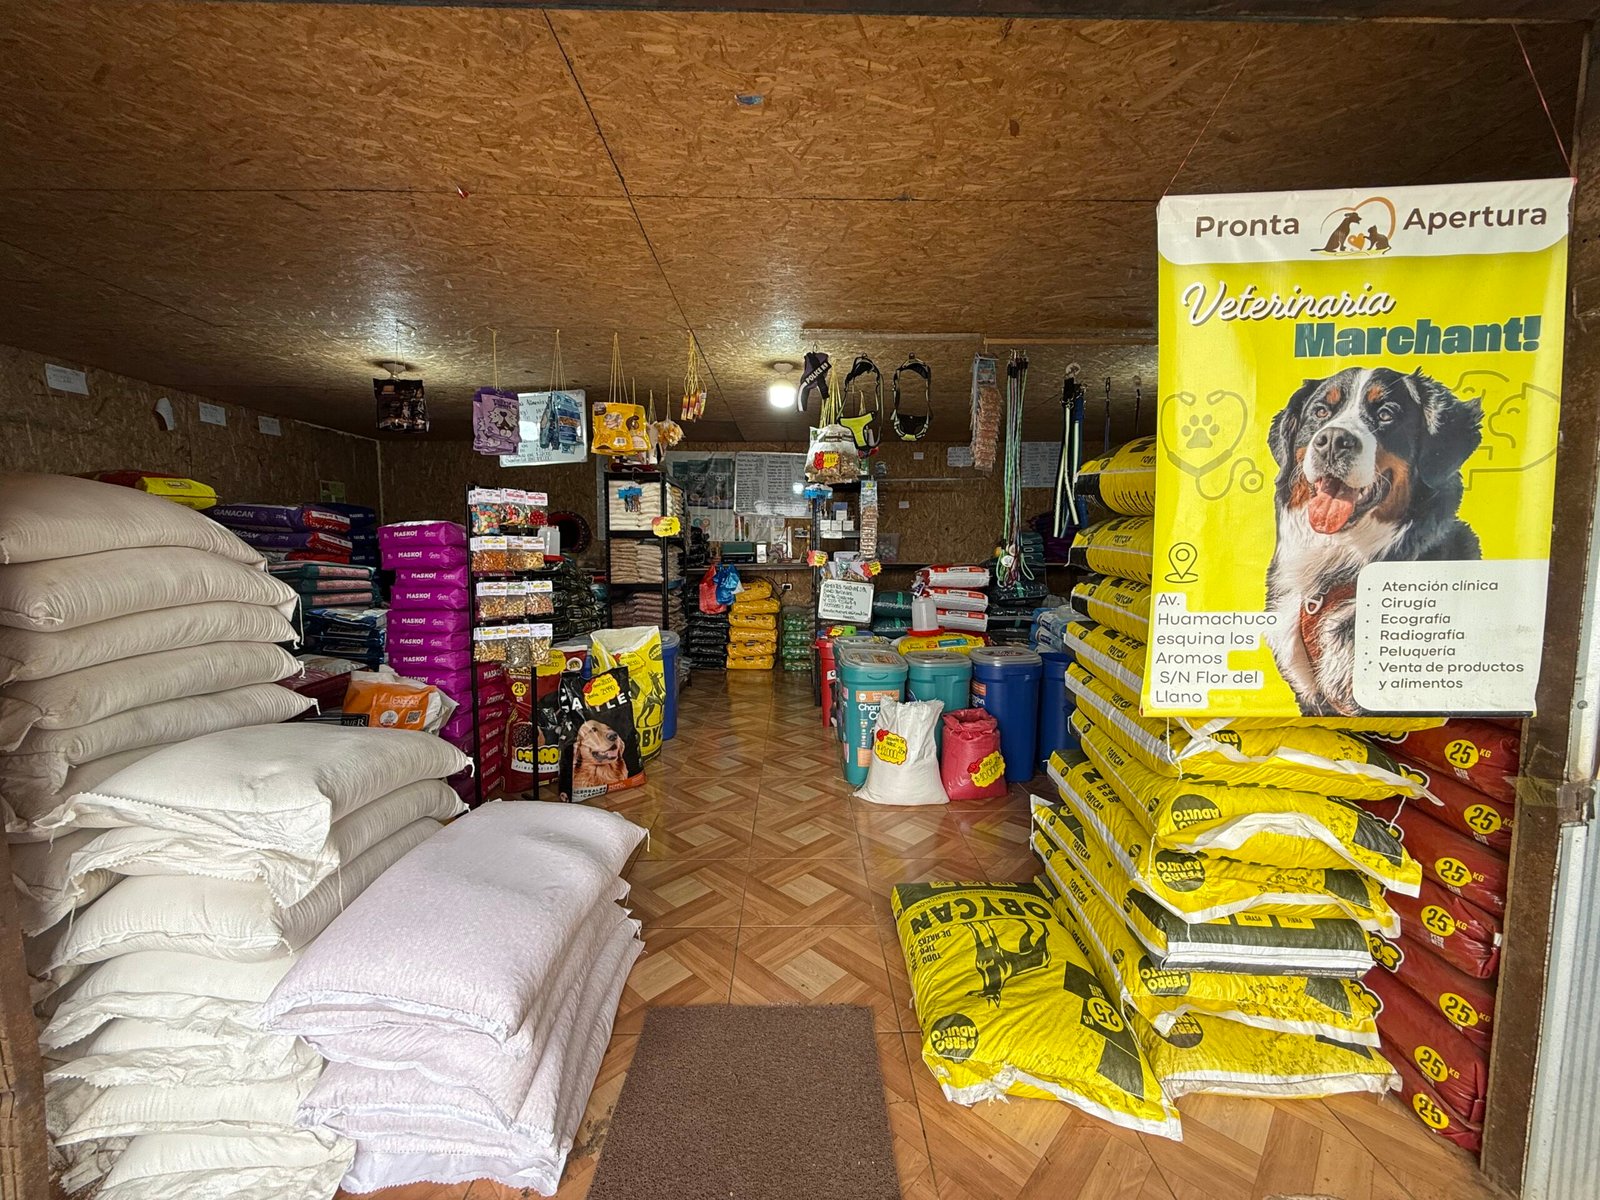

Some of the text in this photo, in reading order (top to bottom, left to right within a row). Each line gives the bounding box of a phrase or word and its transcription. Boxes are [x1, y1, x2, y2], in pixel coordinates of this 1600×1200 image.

[1195, 205, 1548, 238] Pronta Apertura
[1181, 280, 1397, 325] Veterinaria
[1294, 315, 1542, 358] Marchant!
[806, 367, 823, 384] POLICE
[213, 509, 254, 518] GANACAN
[1381, 578, 1498, 592] Atención clínica
[1158, 594, 1181, 606] Av.
[1381, 595, 1437, 611] Cirugía
[1157, 612, 1278, 626] Huamachuco
[1380, 612, 1451, 627] Ecografía
[1156, 631, 1254, 648] esquina los
[1379, 628, 1465, 643] Radiografía
[1155, 651, 1222, 665] Aromos
[1379, 645, 1456, 660] Peluquería
[1379, 660, 1524, 676] Venta de productos
[1160, 670, 1258, 686] S/N Flor del
[1378, 677, 1464, 691] y alimentos
[514, 683, 524, 693] 25
[1155, 689, 1202, 704] Llano
[858, 703, 881, 711] Cham
[1210, 732, 1239, 744] ADU
[1449, 741, 1492, 764] 25 KG
[1172, 807, 1220, 822] ADULTO
[1469, 806, 1496, 831] 25
[1440, 860, 1484, 884] 25 KG
[910, 896, 1052, 935] OBYCAN
[1427, 909, 1468, 932] 25 KG
[921, 952, 942, 964] TODO
[1147, 975, 1188, 991] PERRO
[1092, 1002, 1119, 1028] 25
[1444, 995, 1491, 1023] 25 KG
[931, 1025, 977, 1041] ADULTO
[935, 1036, 975, 1052] PERRO
[1419, 1049, 1461, 1080] 25 KG
[1418, 1096, 1443, 1124] 25
